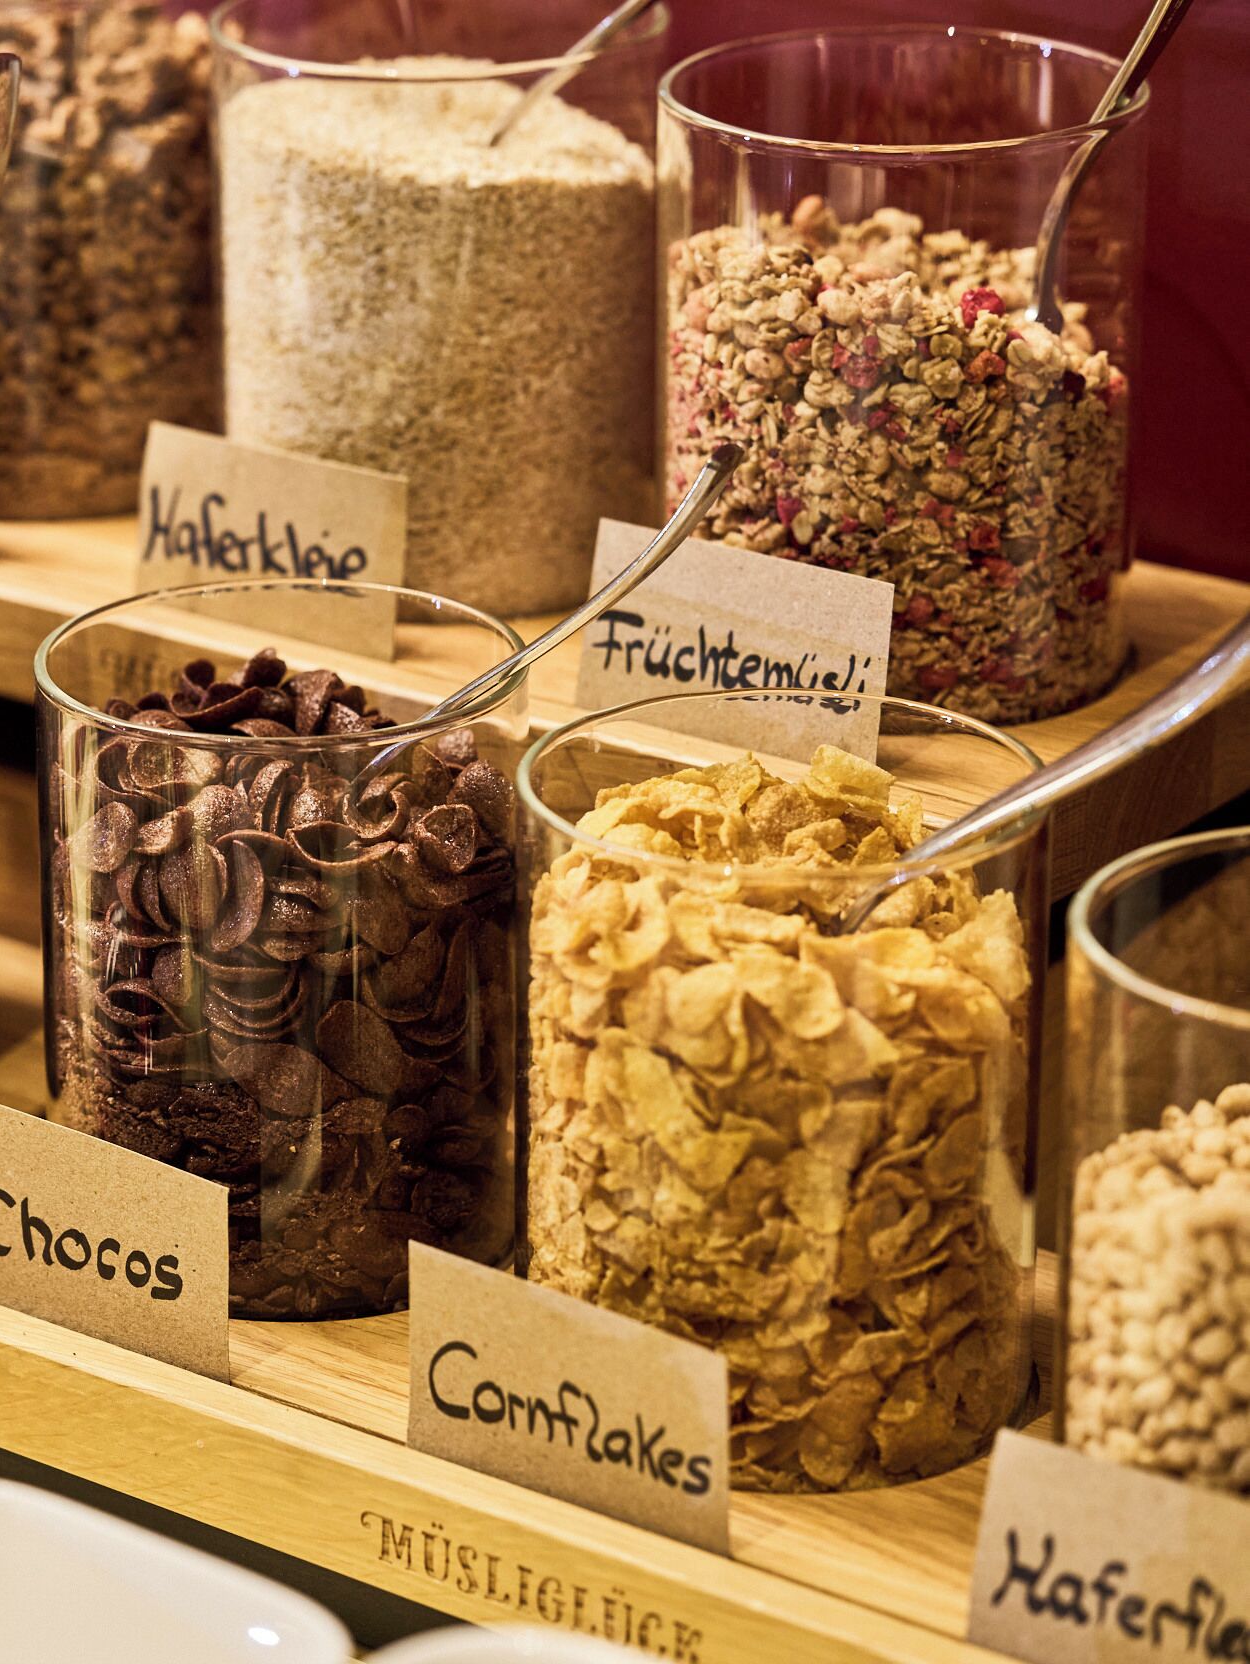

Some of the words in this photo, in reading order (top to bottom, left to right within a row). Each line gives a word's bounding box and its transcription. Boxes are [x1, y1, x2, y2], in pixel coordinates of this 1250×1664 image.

[591, 609, 871, 694] Früchtemüsli
[428, 1340, 713, 1497] Cornflakes
[360, 1510, 703, 1662] MÜSLIGLÜCK
